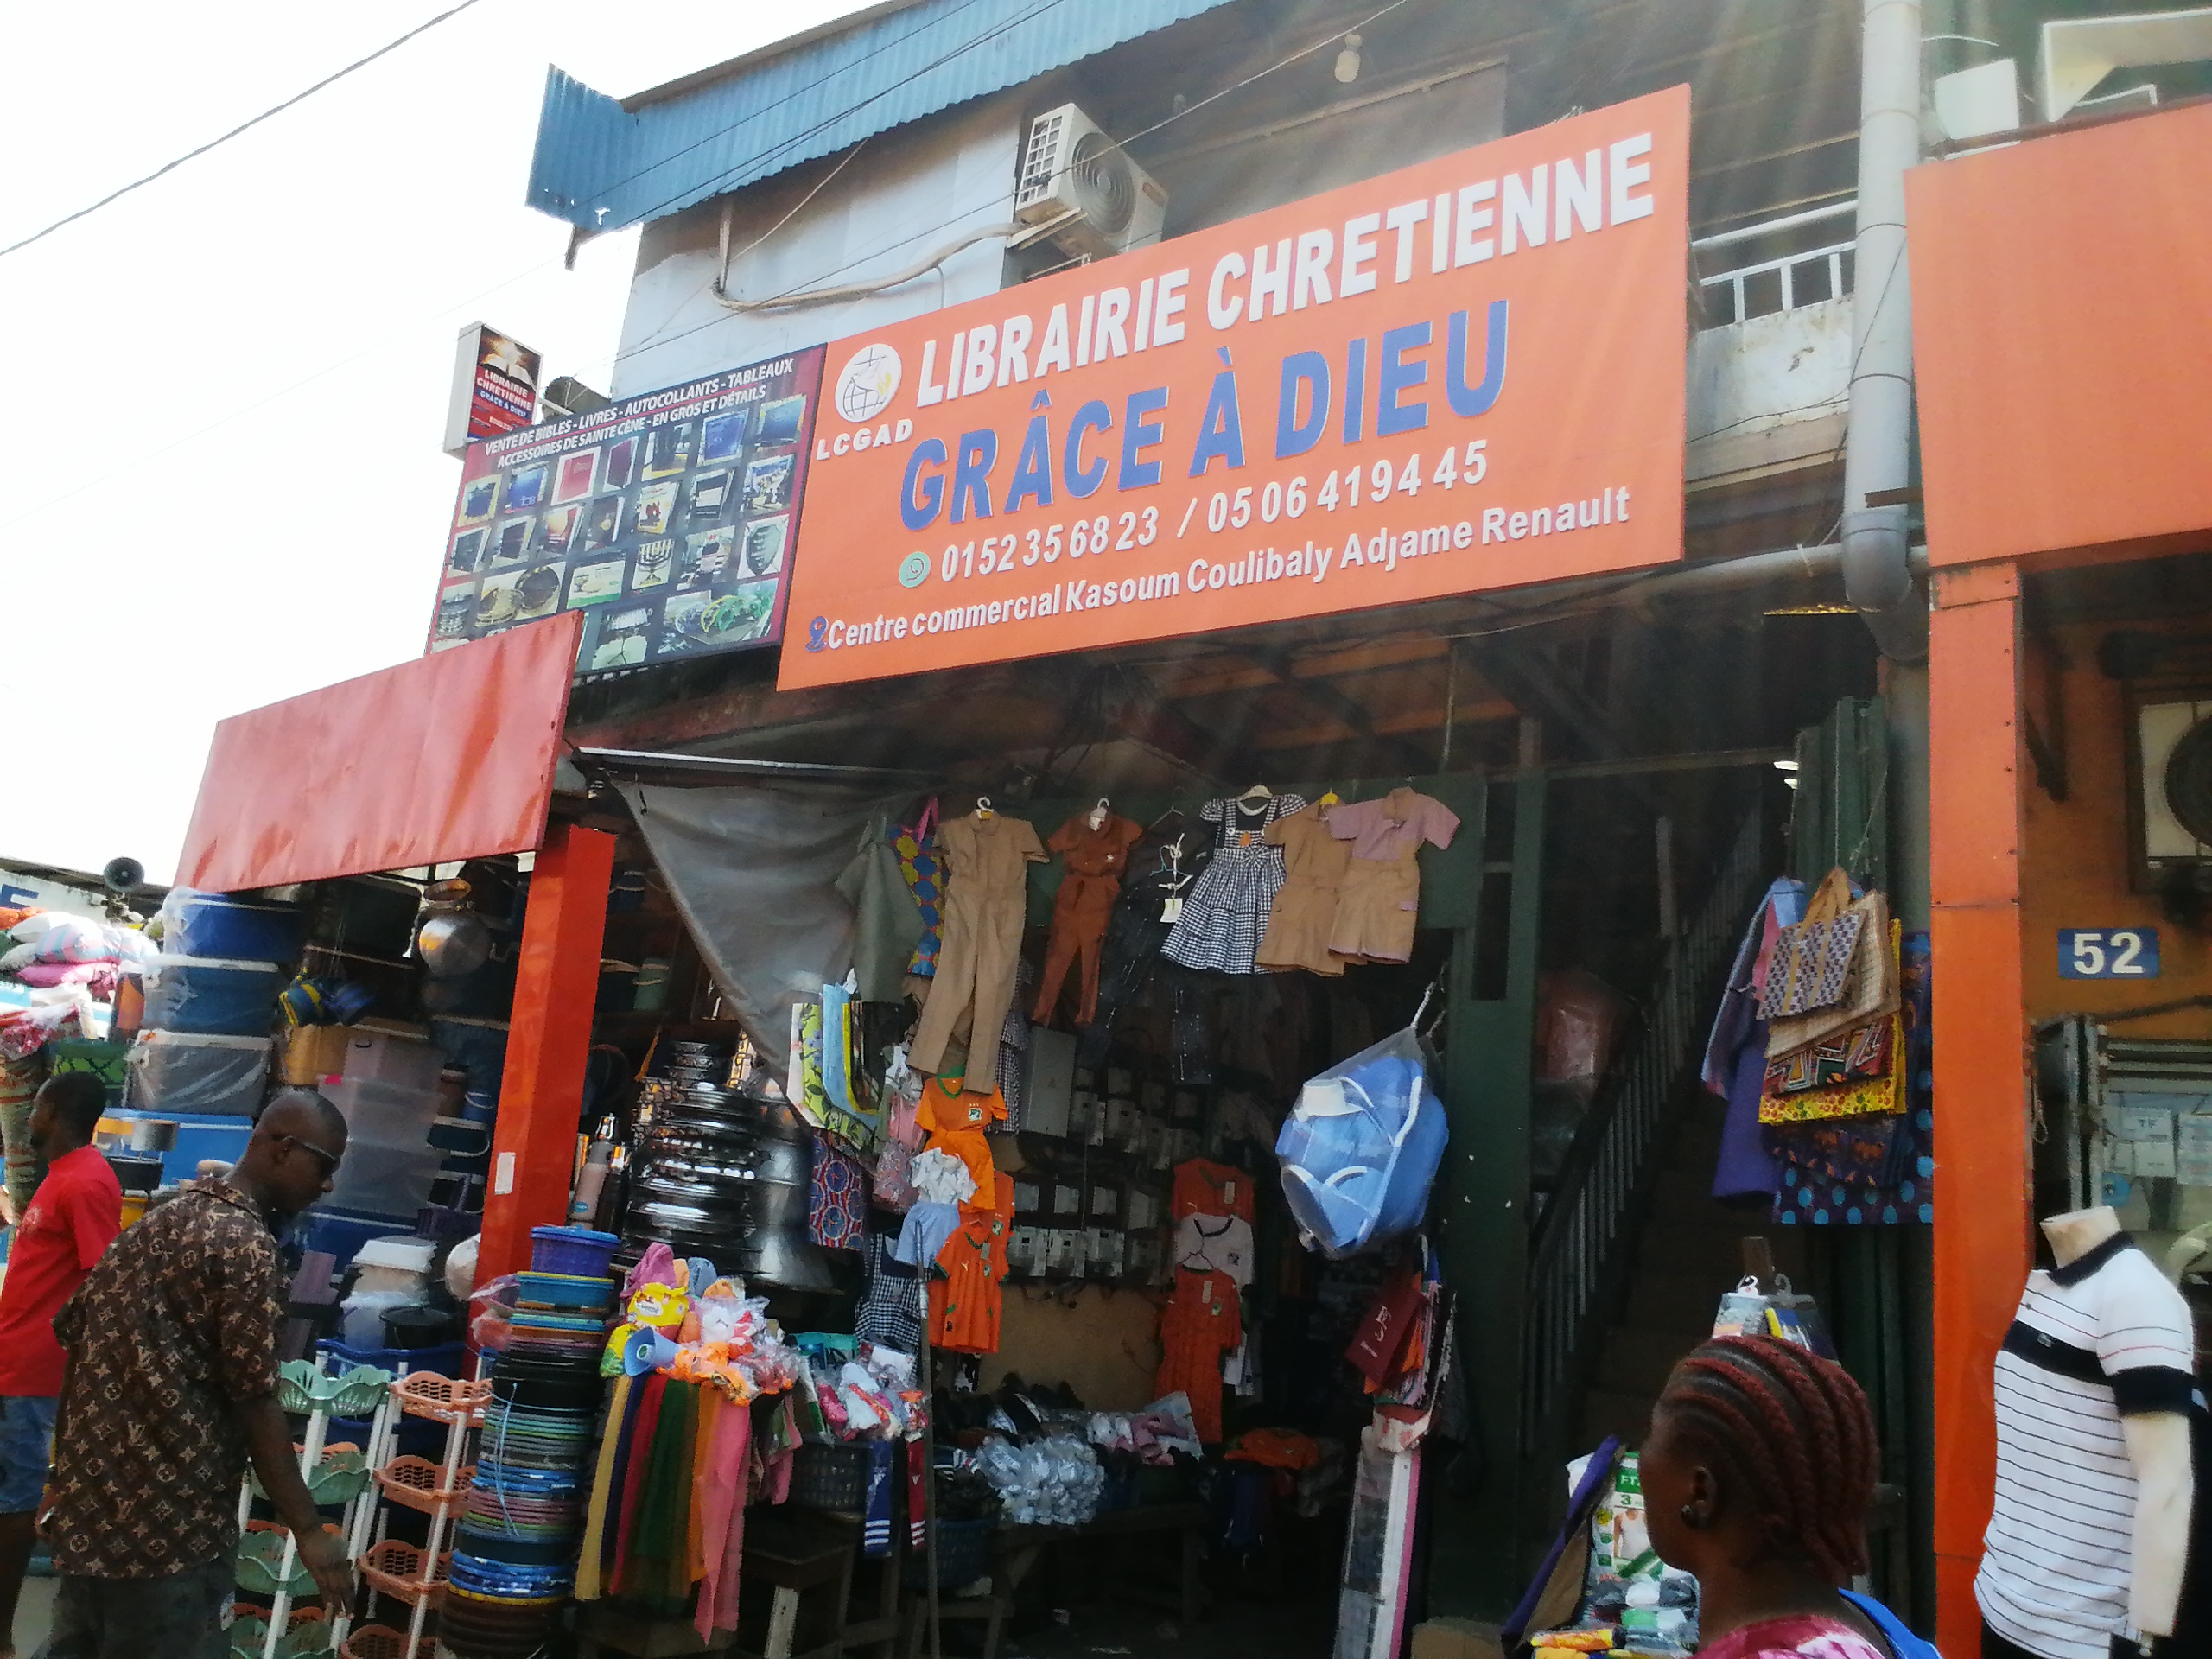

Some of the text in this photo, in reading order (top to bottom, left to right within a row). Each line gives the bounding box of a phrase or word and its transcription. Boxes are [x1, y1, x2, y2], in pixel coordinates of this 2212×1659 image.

[917, 131, 1656, 408] LIBRAIRIE CHRETIENNE
[477, 377, 533, 411] CHRETIENNE
[484, 369, 529, 398] LIBRAIRIE
[485, 435, 518, 456] VENTE
[518, 429, 535, 447] DE
[535, 419, 573, 439] BIBLES
[579, 407, 618, 429] LIVRES
[624, 378, 721, 416] AUTOCOLLANTS
[728, 358, 794, 389] TABLEAUX
[899, 299, 1510, 531] GRÂCE À DIEU
[498, 438, 562, 468] ACCESSOIRES
[563, 435, 578, 452] DE
[578, 424, 617, 447] SAINTE
[652, 410, 669, 427] EN
[670, 402, 701, 422] GROS
[702, 397, 718, 415] ET
[815, 419, 914, 461] LCGAD
[828, 486, 1630, 650] Centre commercial Kasoum Coulibaly Adjame Renault
[2074, 932, 2144, 975] 52
